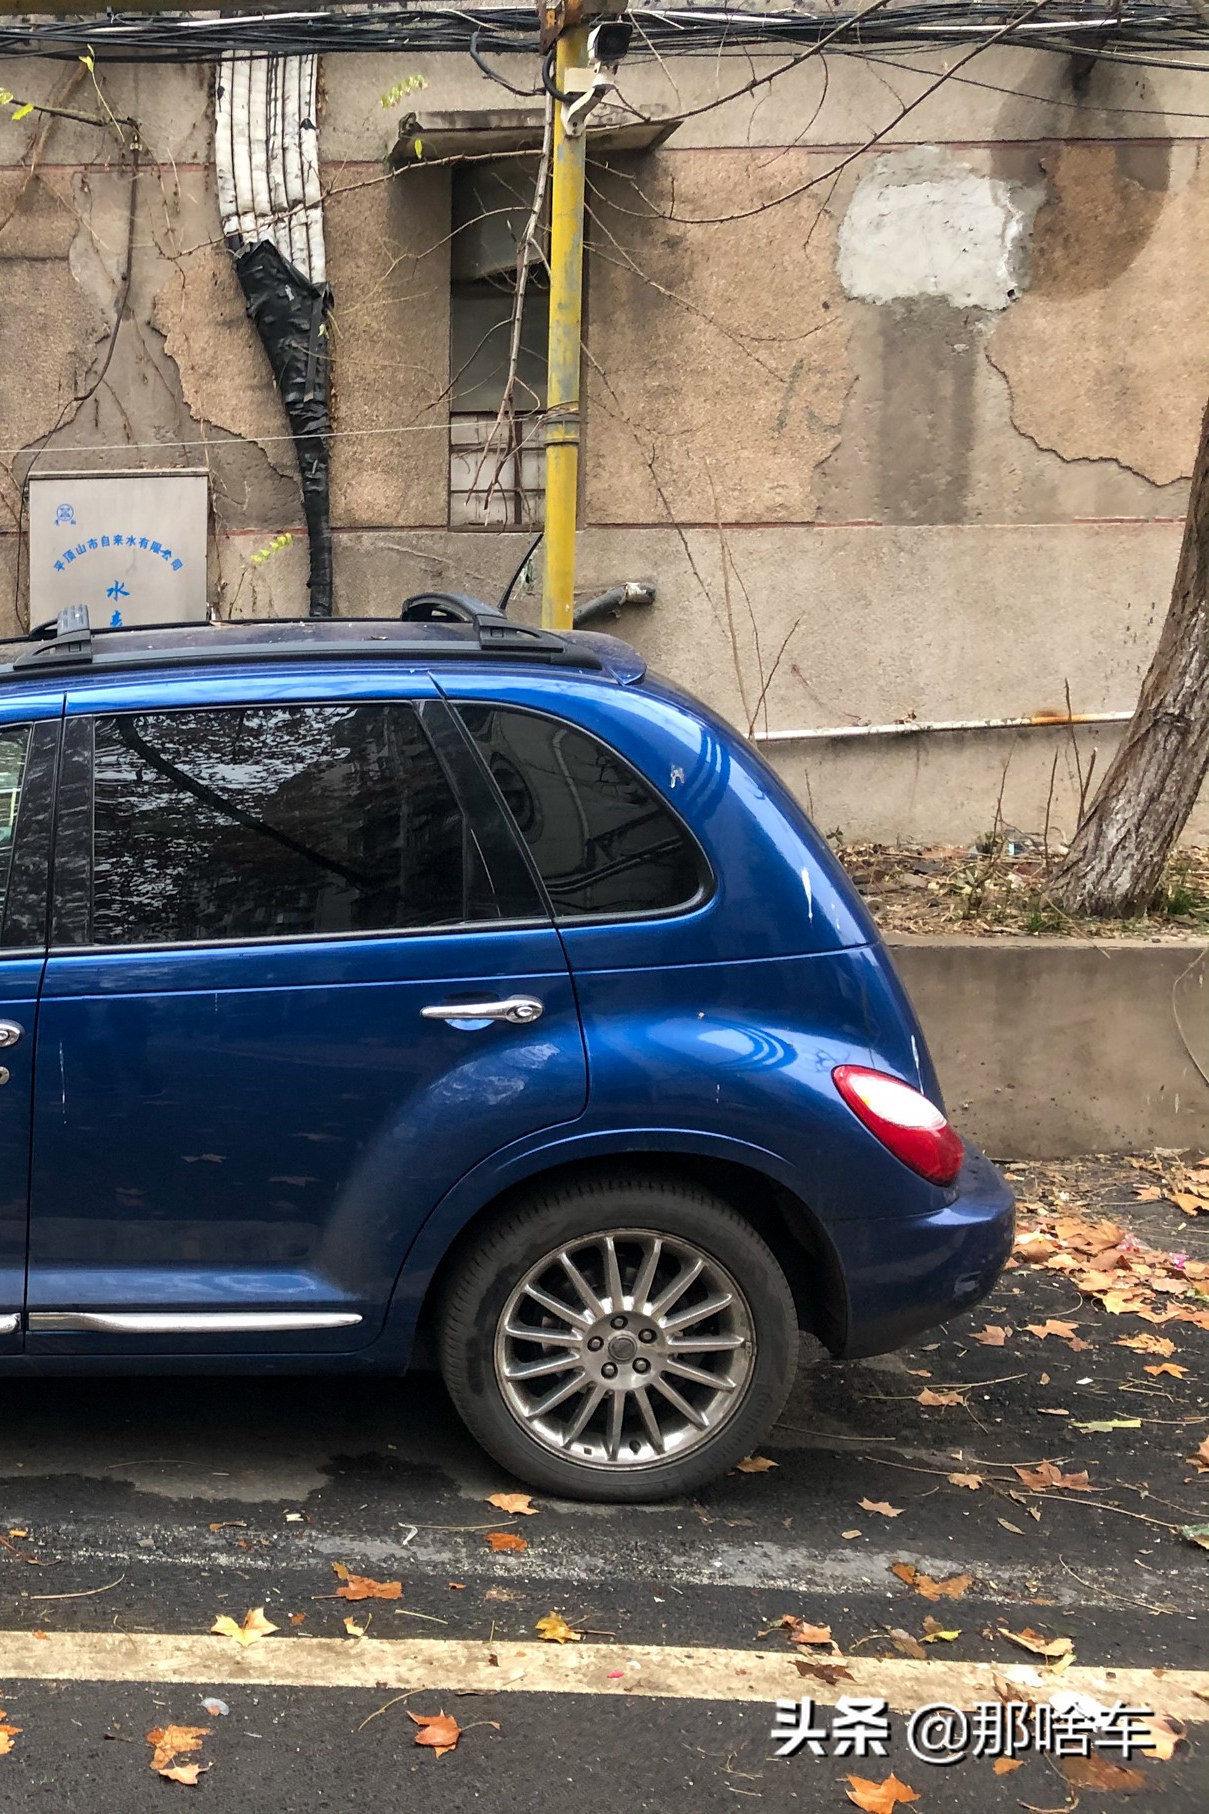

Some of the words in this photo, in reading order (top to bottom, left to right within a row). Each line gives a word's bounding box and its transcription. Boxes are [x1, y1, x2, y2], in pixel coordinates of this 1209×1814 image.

[52, 533, 184, 573] 平顶山市自来水有限公司
